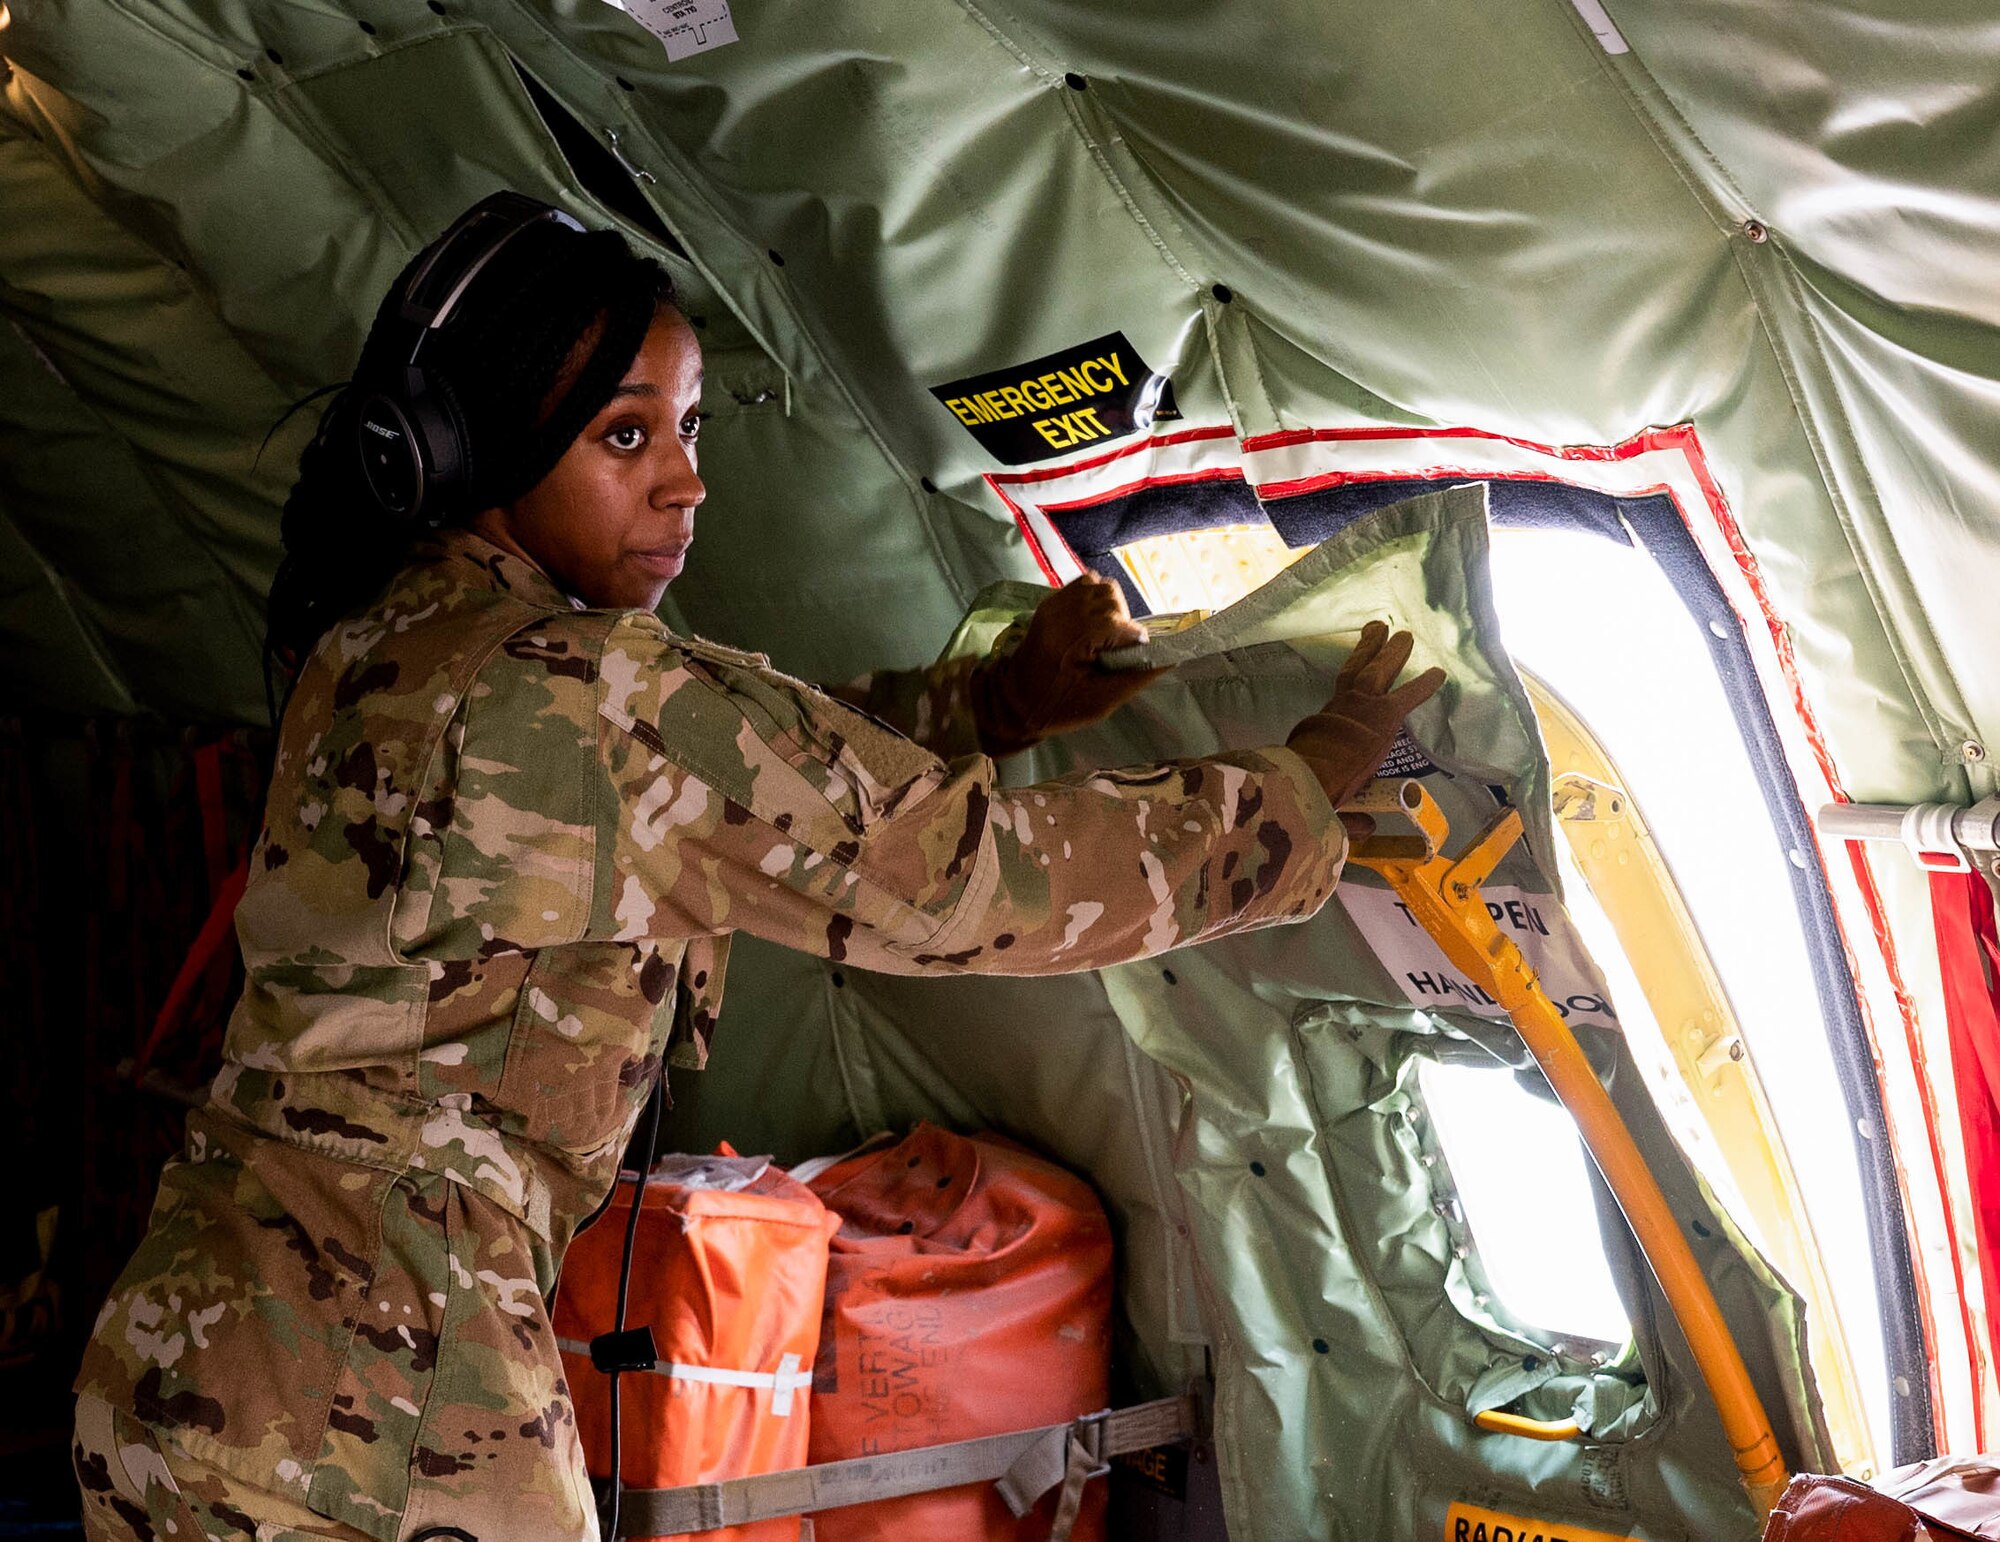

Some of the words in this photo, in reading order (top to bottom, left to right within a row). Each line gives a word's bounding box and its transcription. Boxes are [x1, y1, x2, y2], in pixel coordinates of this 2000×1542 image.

[945, 352, 1129, 426] EMERGENCY
[1032, 407, 1112, 449] EXIT
[1387, 748, 1407, 759] AGE
[1396, 755, 1415, 765] AND
[1376, 767, 1401, 777] HOOK
[1402, 765, 1410, 773] IS
[1485, 900, 1550, 936] PEN
